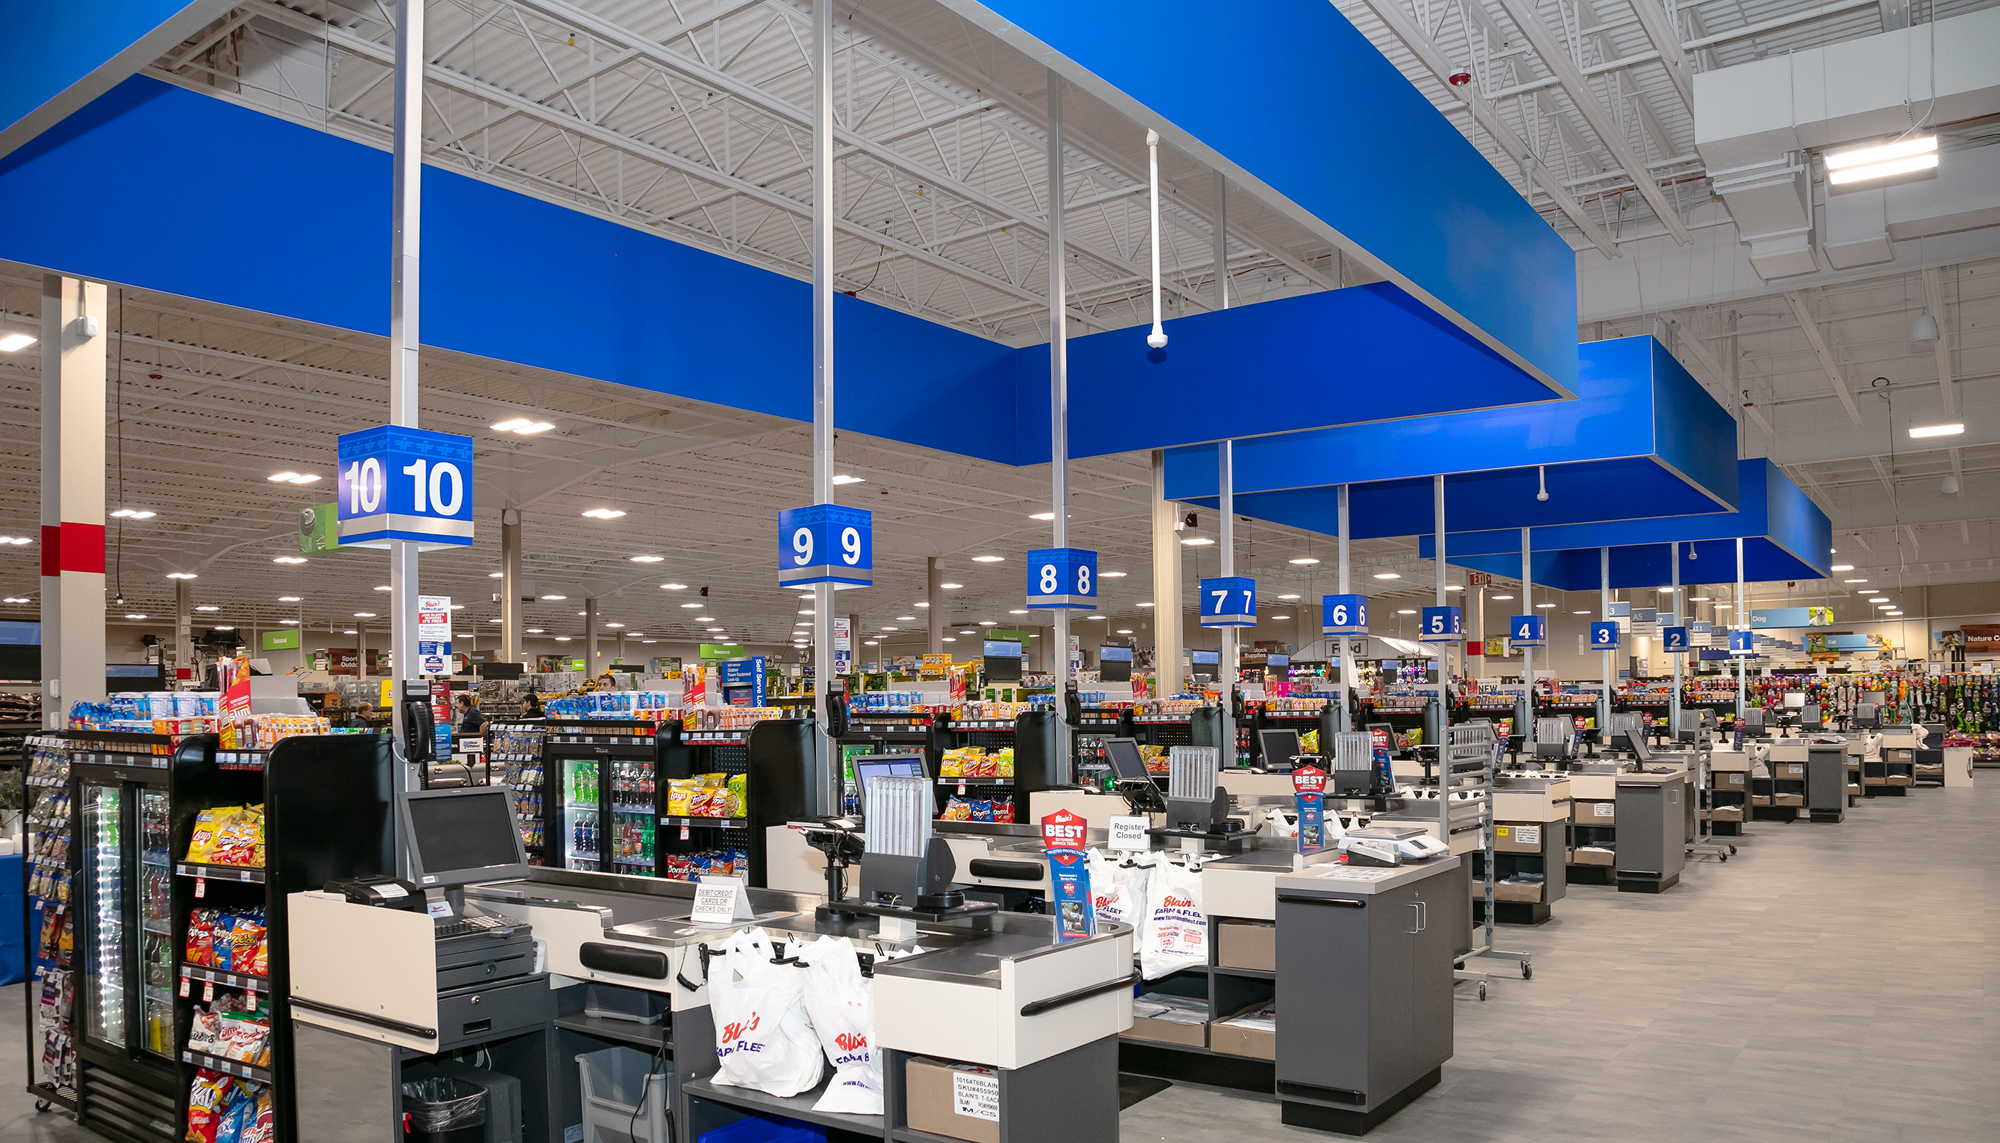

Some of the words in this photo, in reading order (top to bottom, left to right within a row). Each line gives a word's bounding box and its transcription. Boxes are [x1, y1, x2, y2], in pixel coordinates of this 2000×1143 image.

[344, 457, 381, 515] 10
[403, 458, 464, 517] 10
[792, 527, 814, 565] 9
[841, 527, 861, 565] 9
[1039, 564, 1058, 594] 8
[1077, 565, 1091, 595] 8
[1211, 590, 1229, 614] 7
[1243, 590, 1252, 614] 7
[1332, 604, 1348, 626] 6
[1359, 604, 1366, 626] 6
[1752, 615, 1767, 623] Dog
[1431, 615, 1444, 634] 5
[1453, 615, 1460, 634] 5
[1518, 623, 1531, 640] 4
[1598, 628, 1610, 644] 3
[1670, 633, 1681, 647] 2
[1736, 637, 1744, 650] 1
[755, 658, 763, 673] Self
[1478, 684, 1498, 693] NEW
[1294, 775, 1325, 785] BEST
[1045, 823, 1084, 839] BEST
[1114, 822, 1146, 832] Register
[1115, 831, 1142, 840] Closed
[698, 889, 733, 898] DEBIT/CREDIT
[700, 897, 719, 905] CARDS
[1154, 907, 1176, 916] FARM
[957, 1091, 979, 1100] BLAIN'S
[981, 1095, 999, 1103] T-SAC
